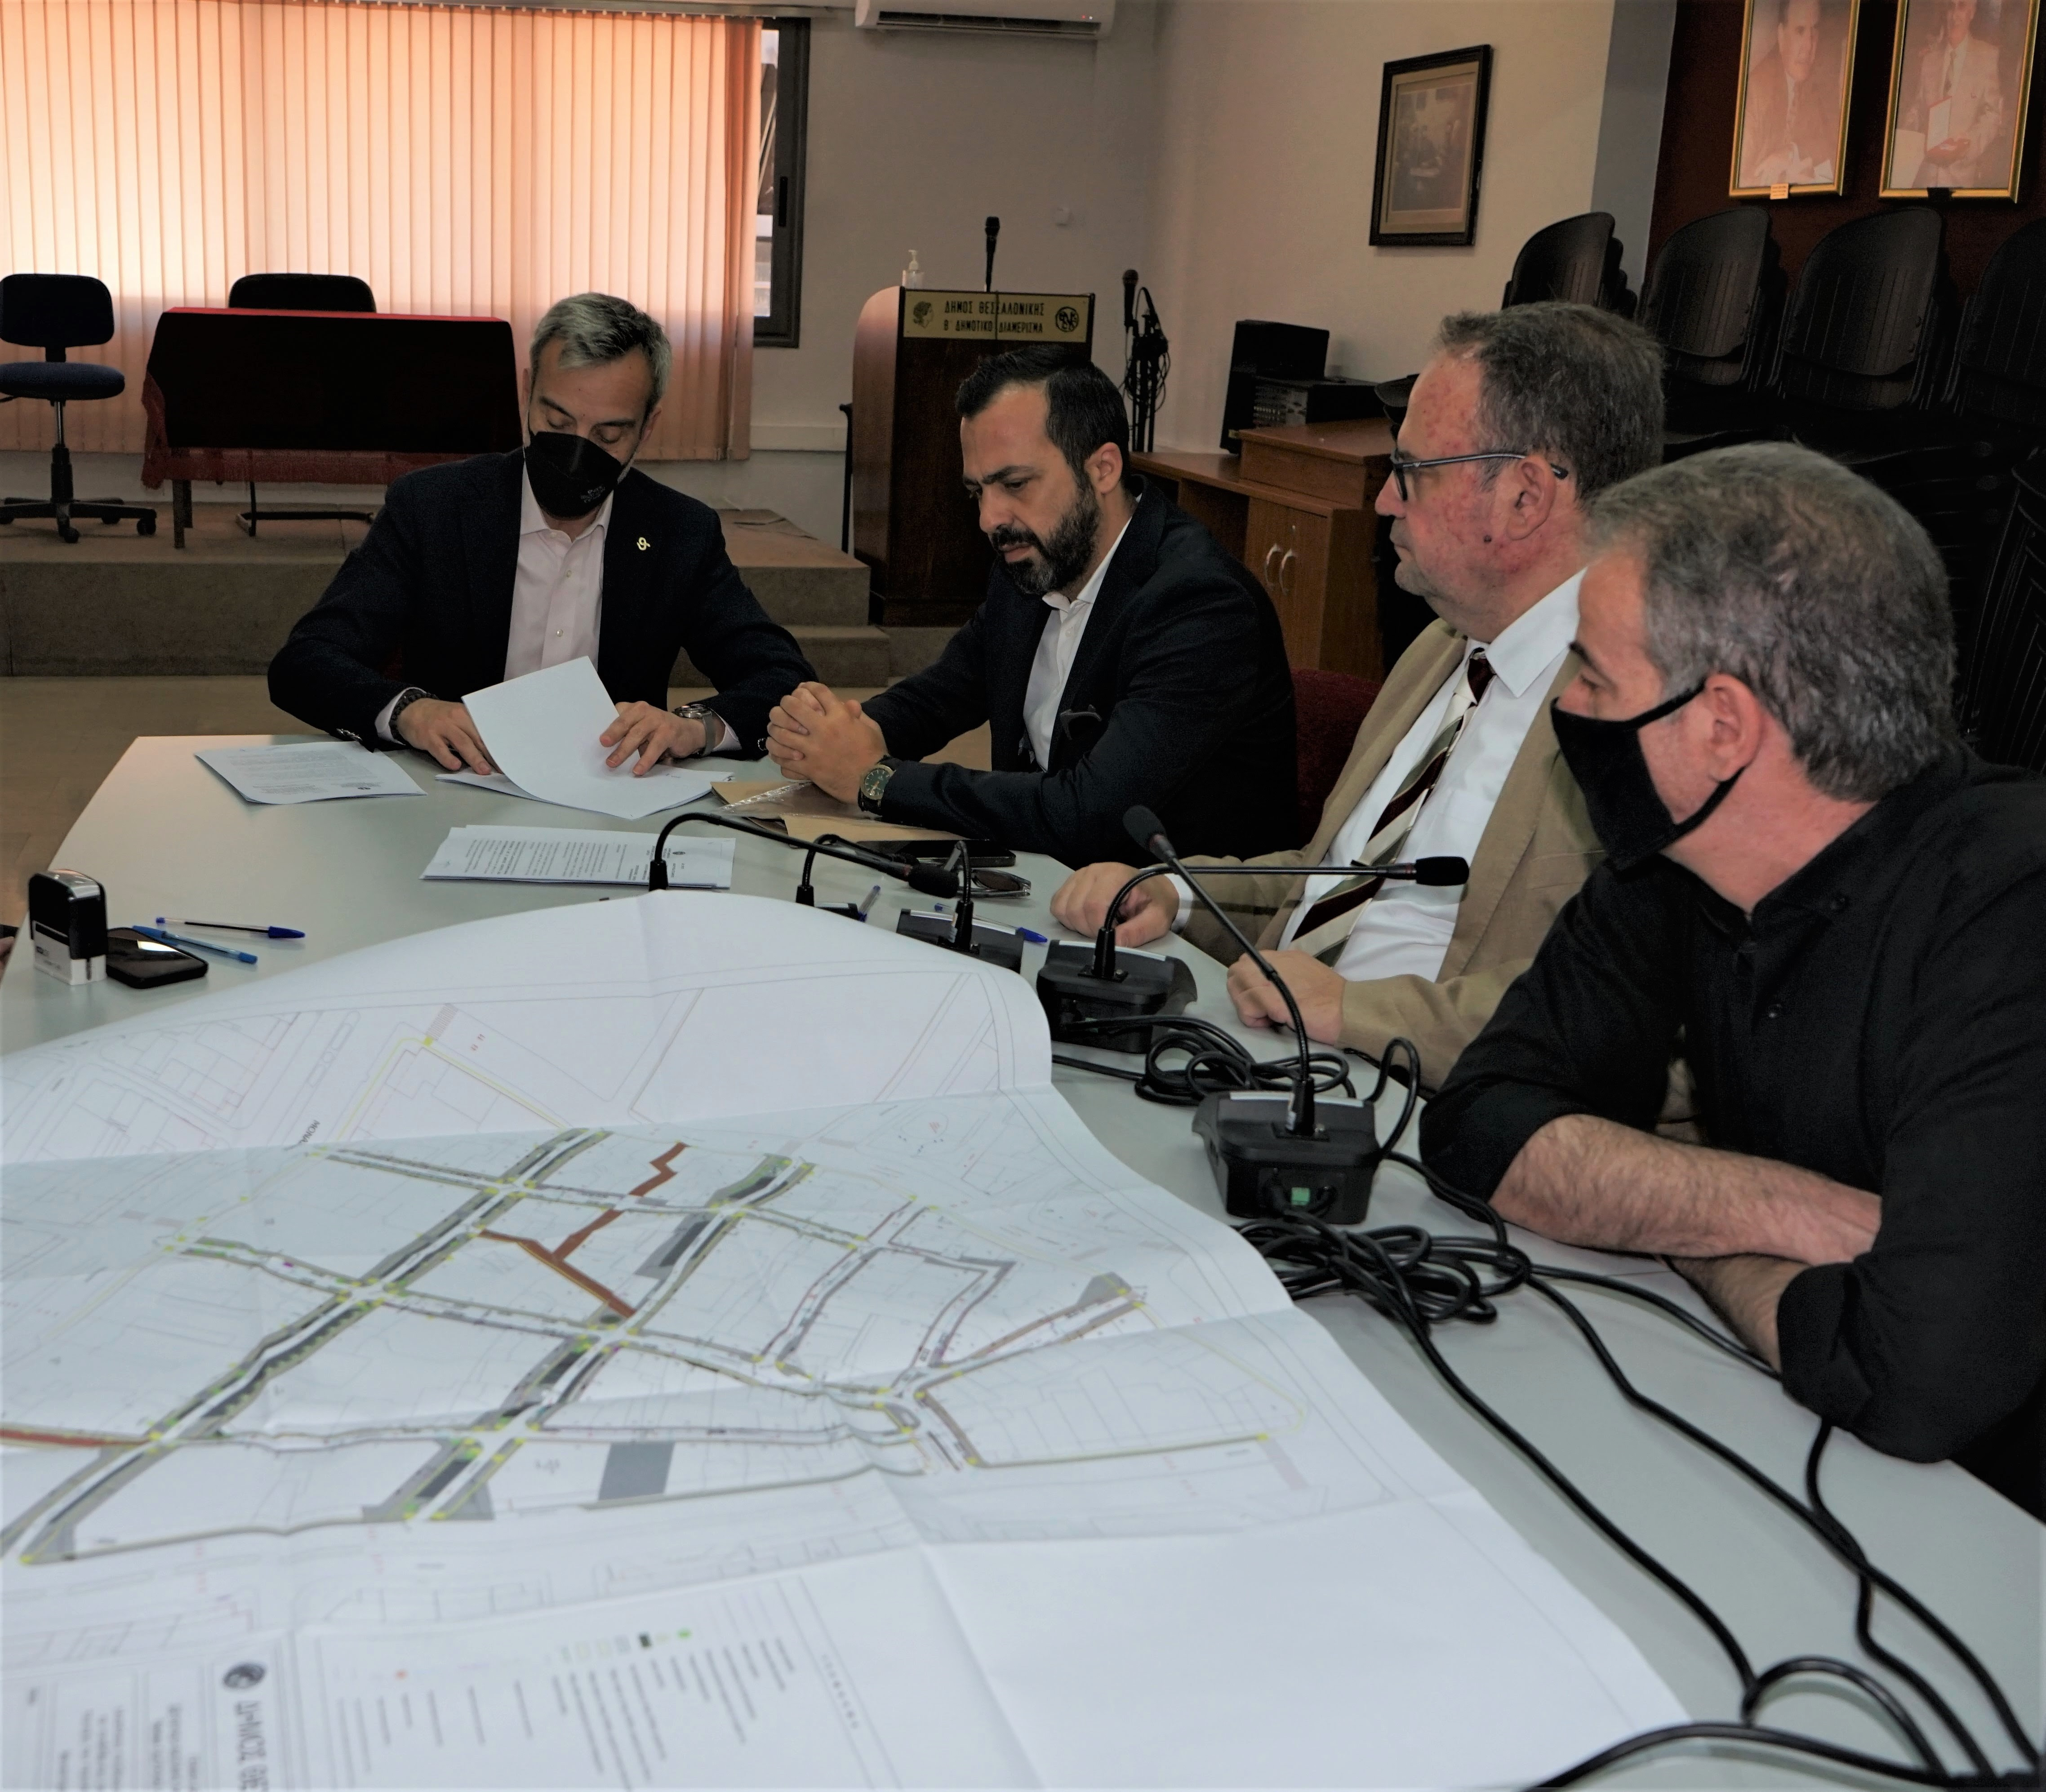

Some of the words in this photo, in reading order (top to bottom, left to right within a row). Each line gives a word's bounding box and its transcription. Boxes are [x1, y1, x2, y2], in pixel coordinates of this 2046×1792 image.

[944, 300, 973, 313] ΔΗΜΟΣ
[979, 301, 1044, 316] ΘΕΣΣΑΛΟΝΙΚΗΣ
[956, 320, 992, 332] ΔΗΜΟΤΙΚΟ
